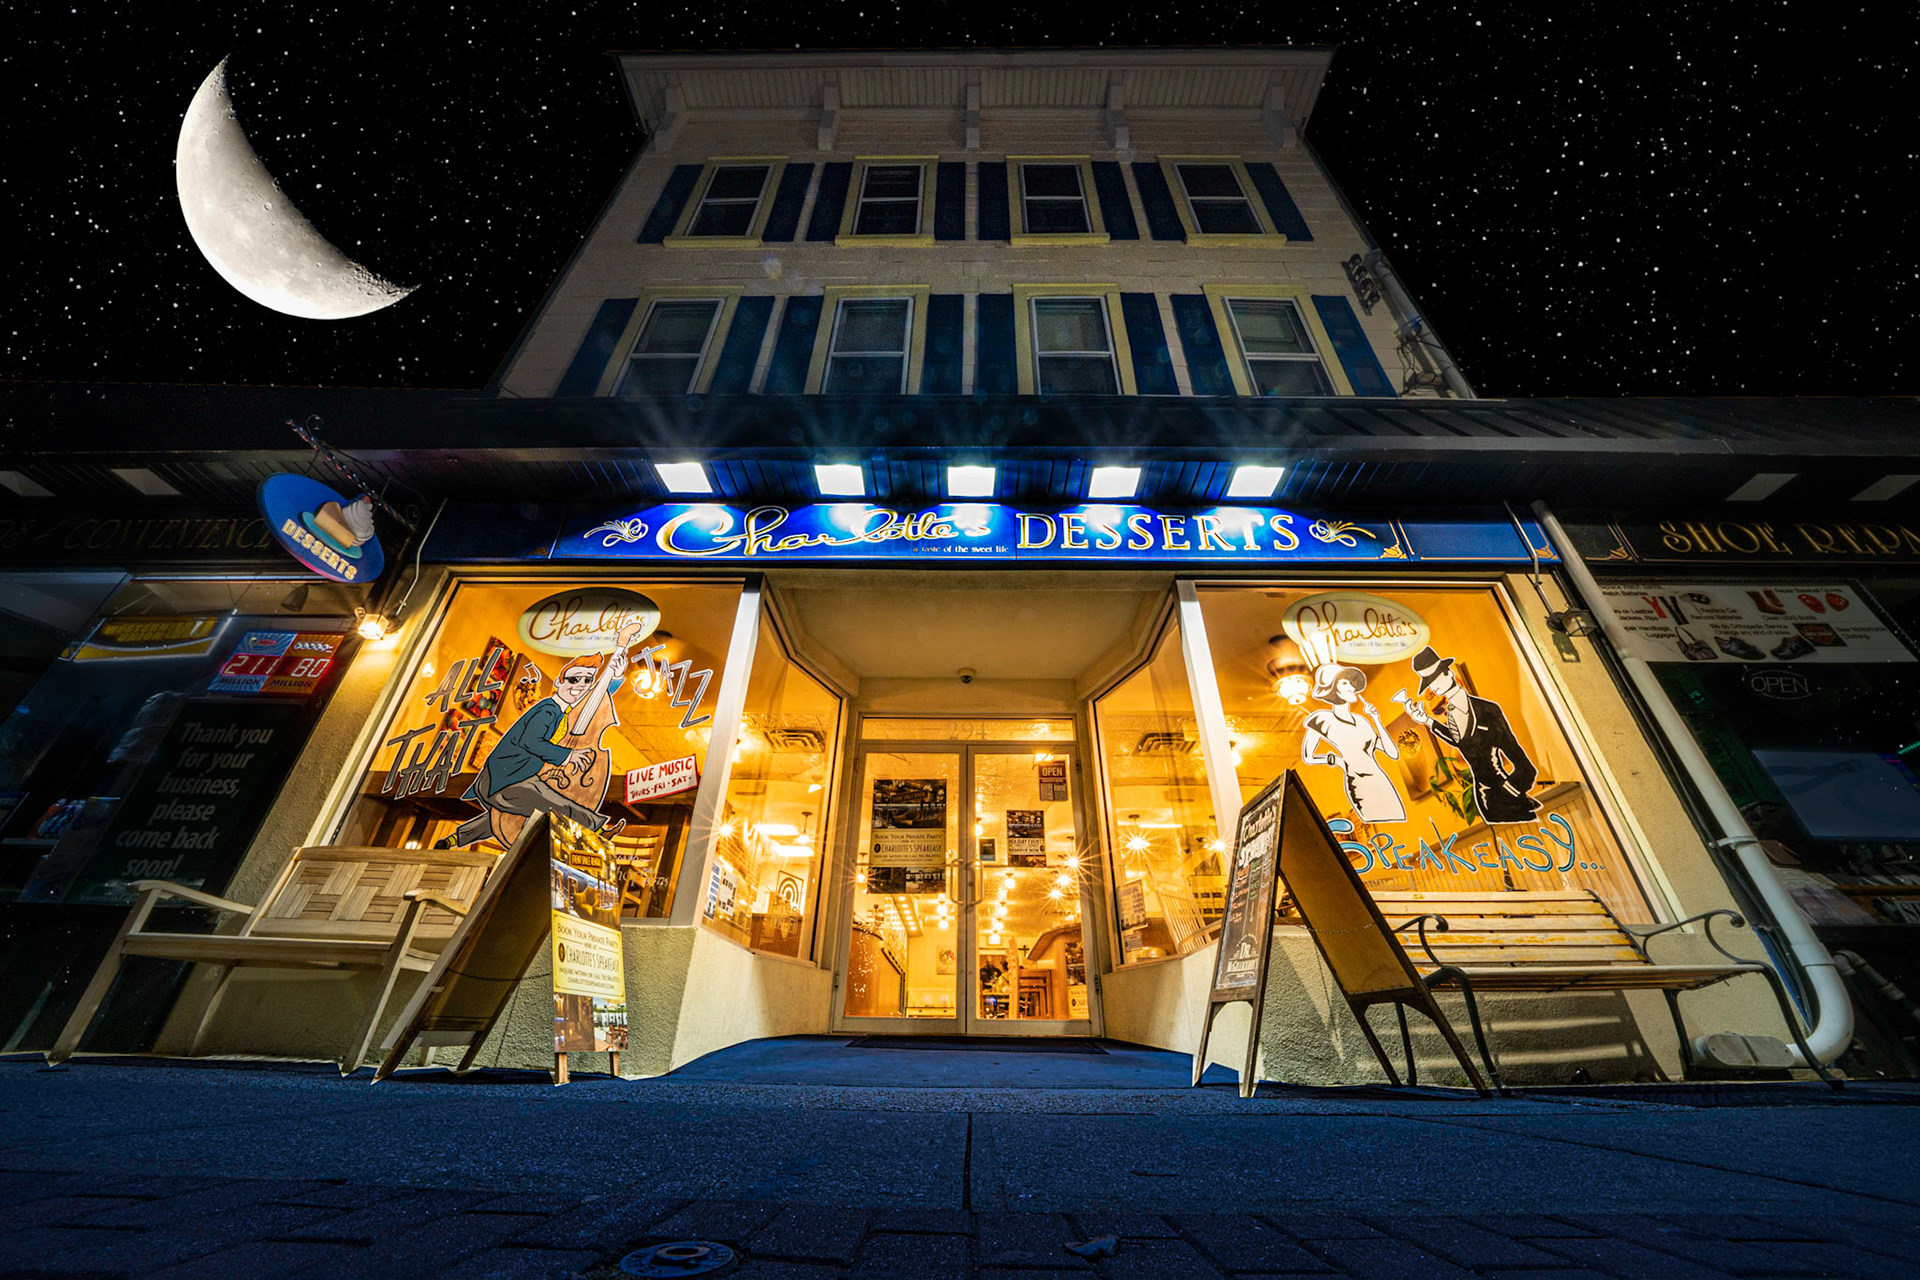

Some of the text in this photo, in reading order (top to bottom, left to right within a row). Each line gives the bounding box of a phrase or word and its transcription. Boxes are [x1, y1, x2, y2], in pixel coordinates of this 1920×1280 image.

[655, 505, 1300, 556] Charlottes DESSERTS
[1659, 520, 1793, 556] SHOE
[281, 518, 358, 580] DESSERTS
[528, 595, 646, 641] Charlott's
[1296, 601, 1419, 645] Charlotte's
[223, 655, 330, 678] 211 80
[425, 646, 504, 713] ALL
[219, 677, 312, 688] MILLION MILLION
[630, 643, 715, 729] JAZZ
[1750, 676, 1810, 693] OPEN
[179, 721, 275, 750] Thank you
[175, 746, 255, 774] for your
[381, 714, 498, 801] THAT
[629, 757, 693, 786] LIVE MUSIC
[1042, 766, 1063, 777] OPEN
[155, 771, 241, 799] business,
[146, 797, 217, 826] please
[115, 825, 221, 850] come back
[913, 844, 942, 853] SPEAKEASY
[121, 854, 185, 877] soon!
[557, 922, 573, 936] BOOK
